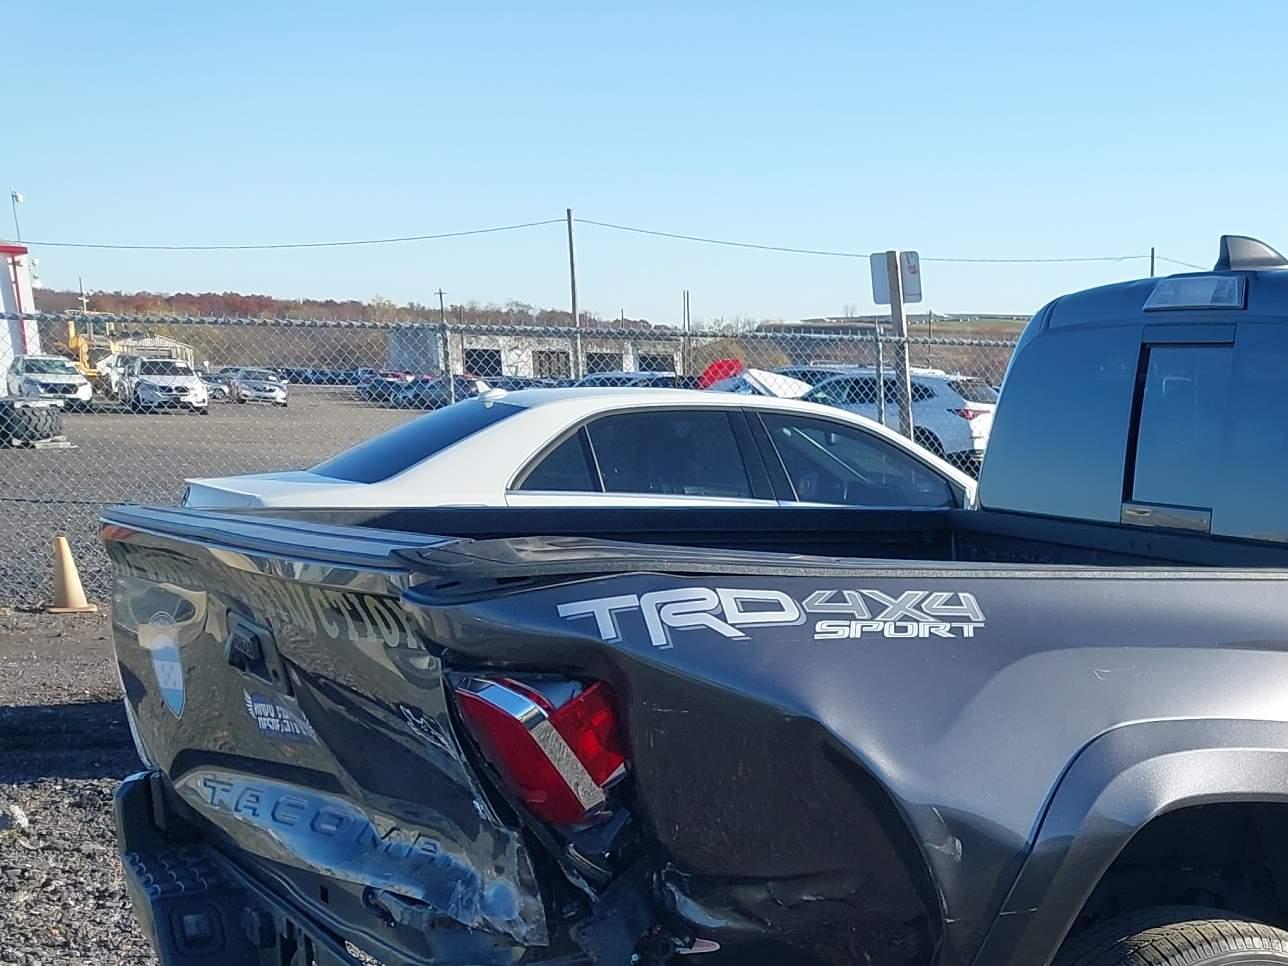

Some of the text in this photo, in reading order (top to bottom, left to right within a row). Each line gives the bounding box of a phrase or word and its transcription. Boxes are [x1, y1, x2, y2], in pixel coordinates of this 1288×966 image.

[557, 587, 807, 650] TRD
[813, 620, 986, 640] SPORT
[202, 777, 442, 859] TACOMA
